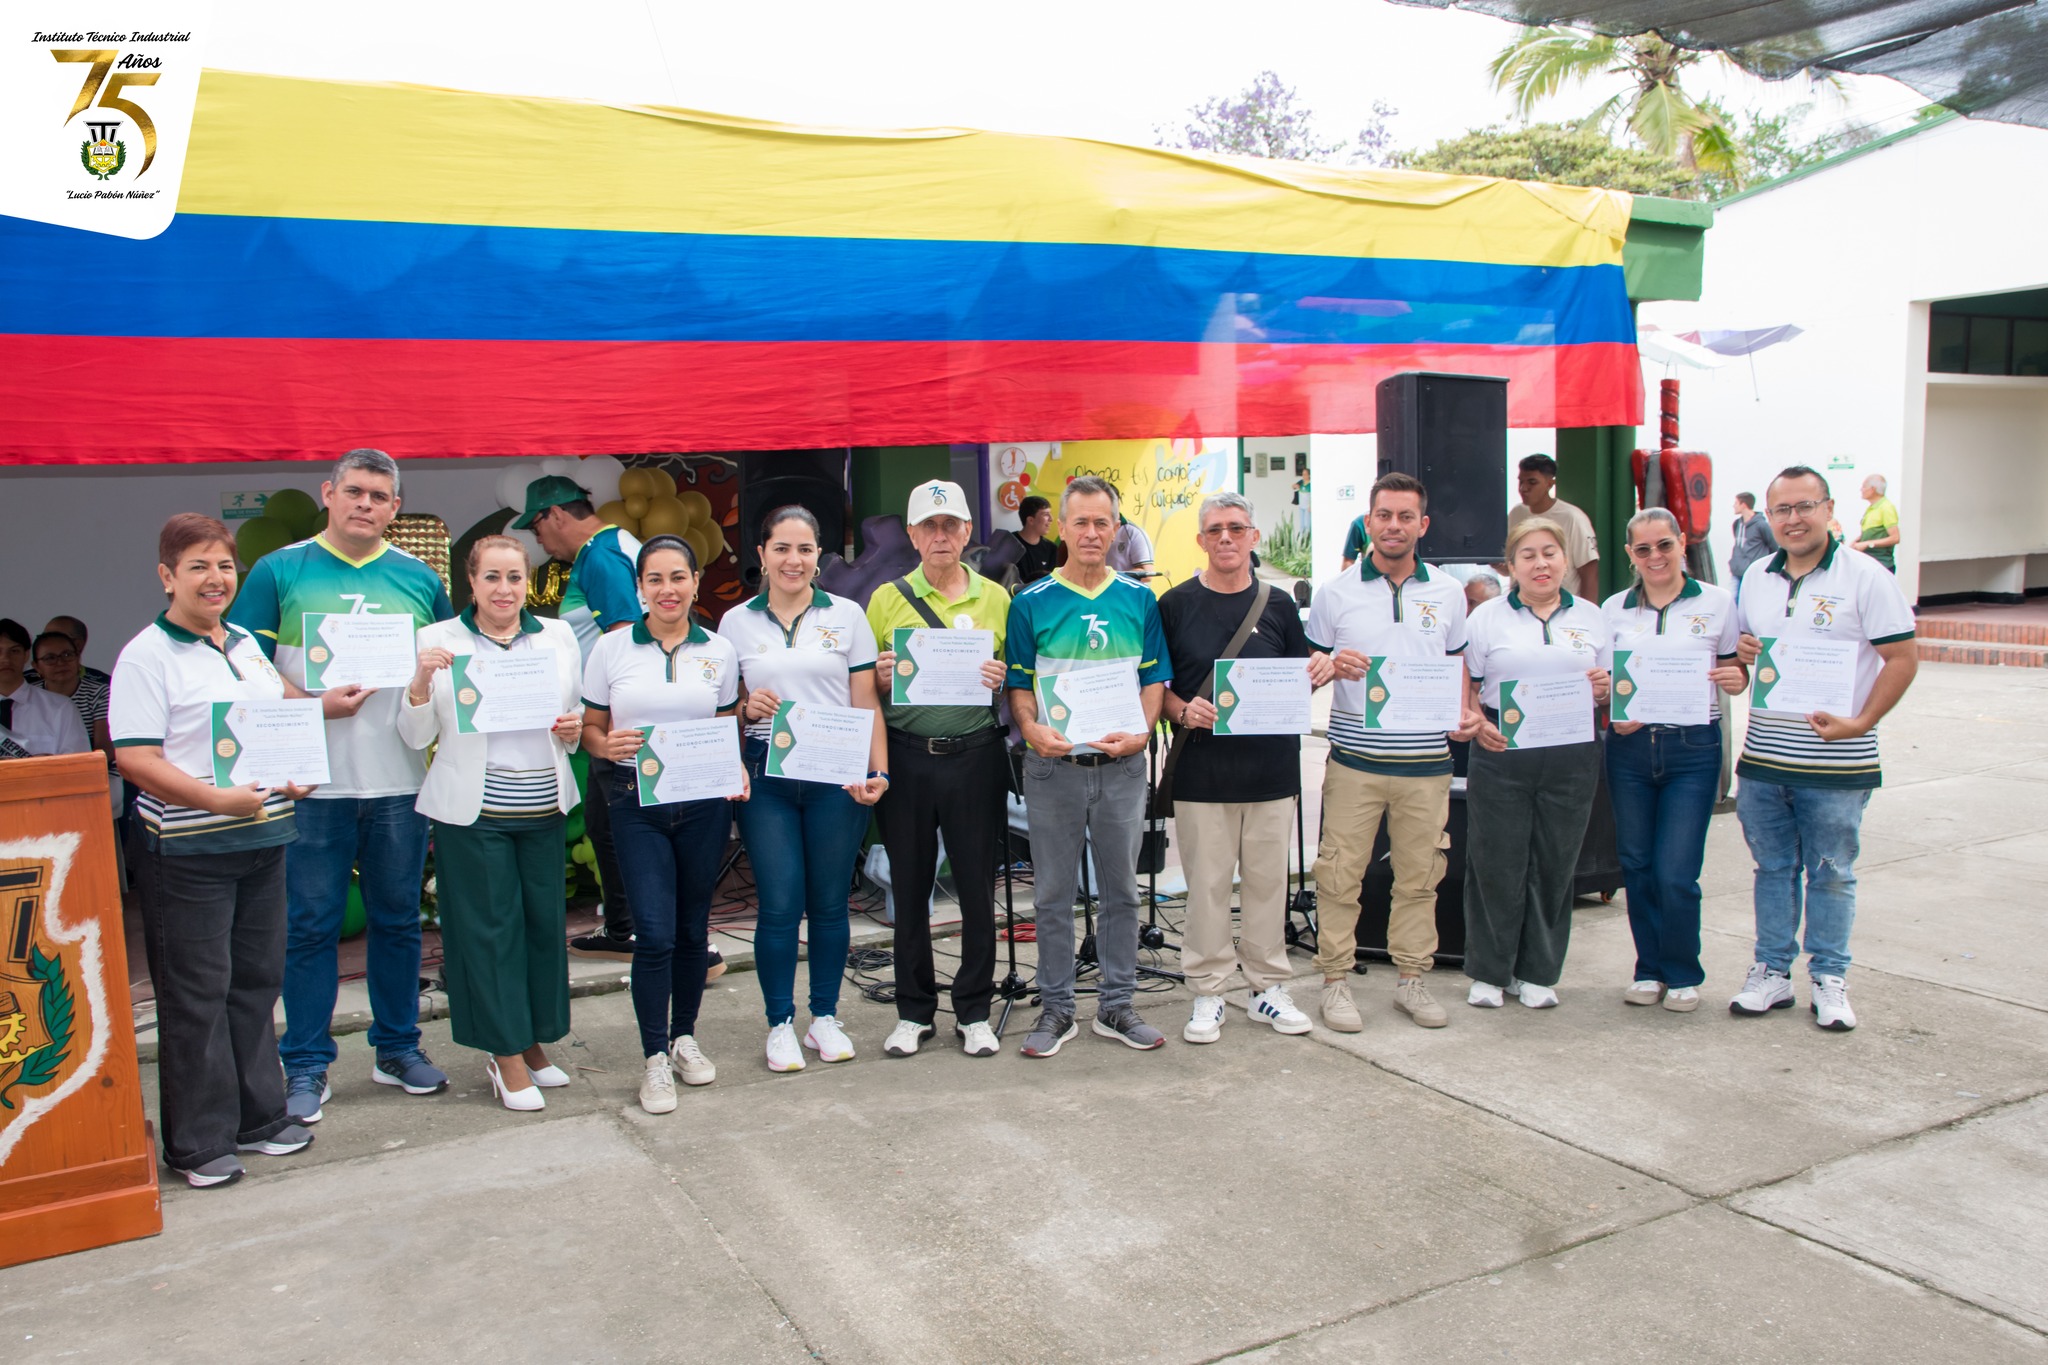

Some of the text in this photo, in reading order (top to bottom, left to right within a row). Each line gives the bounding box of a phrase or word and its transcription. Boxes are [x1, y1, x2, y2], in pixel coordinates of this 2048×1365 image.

[928, 486, 947, 505] 75
[816, 627, 840, 649] 75
[1080, 614, 1110, 651] 75
[696, 658, 718, 681] 75
[812, 724, 859, 733] RECONOCIMIENTO
[676, 738, 724, 748] RECONOCIMIENTO
